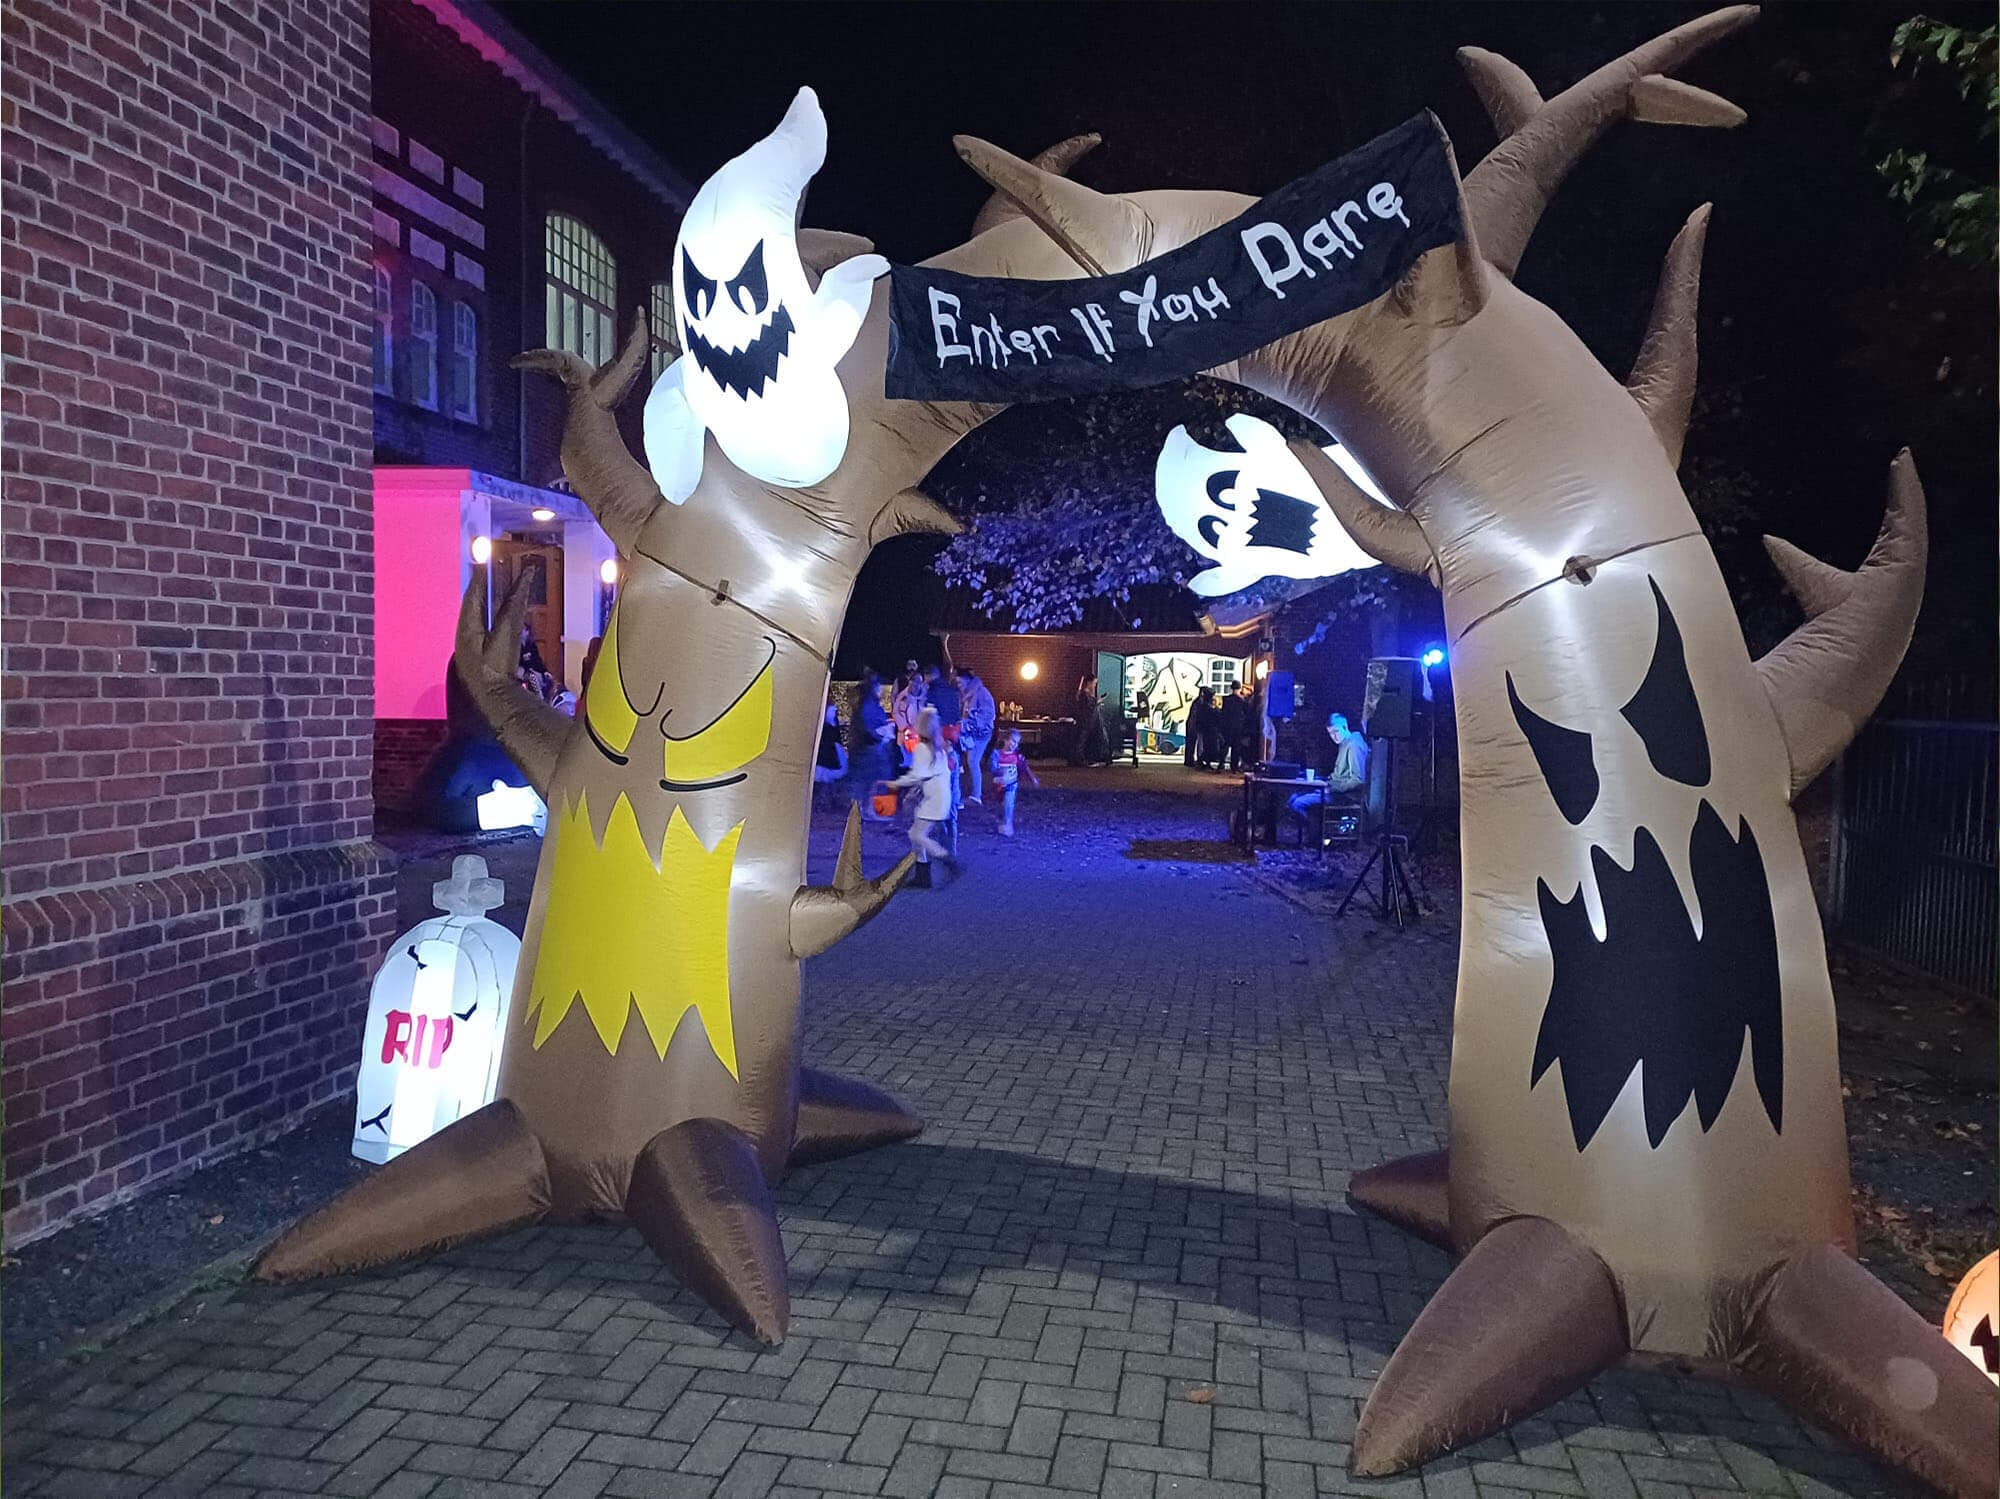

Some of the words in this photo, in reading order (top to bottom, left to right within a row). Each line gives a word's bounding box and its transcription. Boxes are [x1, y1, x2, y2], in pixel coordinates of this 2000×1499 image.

[928, 286, 1062, 369] Enter
[1070, 303, 1116, 364] If
[1118, 274, 1231, 348] You
[1240, 182, 1411, 300] Dare
[381, 1009, 454, 1069] RIP
